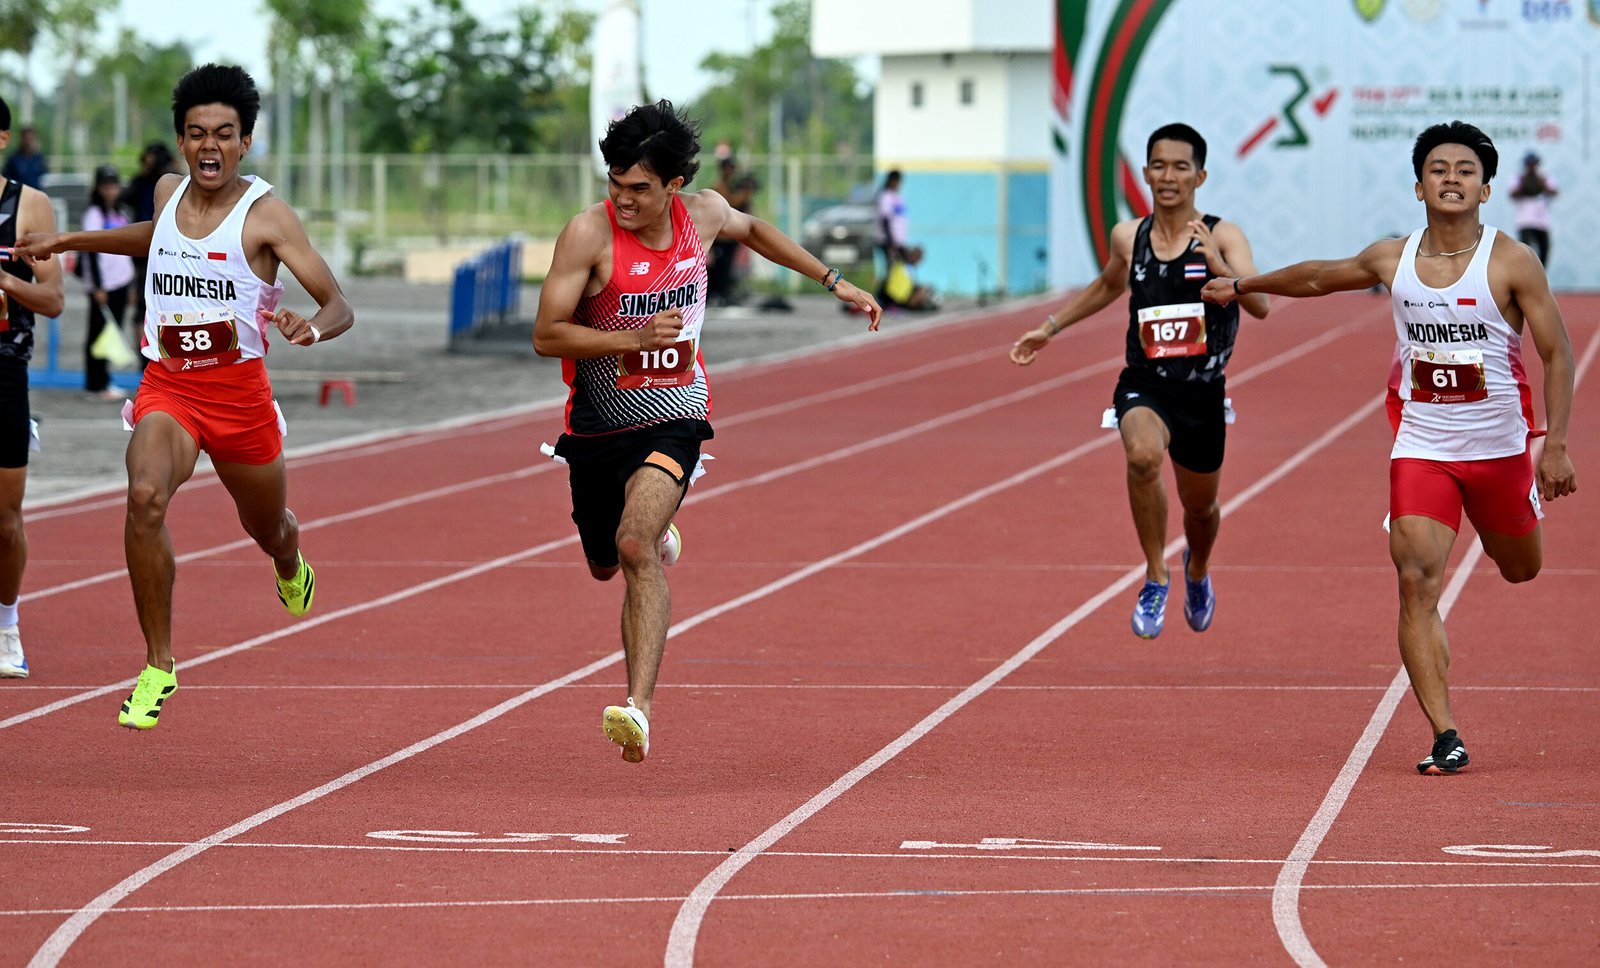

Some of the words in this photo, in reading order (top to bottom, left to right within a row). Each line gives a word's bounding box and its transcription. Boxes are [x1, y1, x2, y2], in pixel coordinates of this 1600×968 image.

[152, 273, 237, 301] INDONESIA
[618, 281, 699, 317] SINGAPORE
[178, 330, 212, 352] 38
[1151, 321, 1189, 342] 167
[640, 348, 679, 369] 110
[1432, 369, 1458, 388] 61
